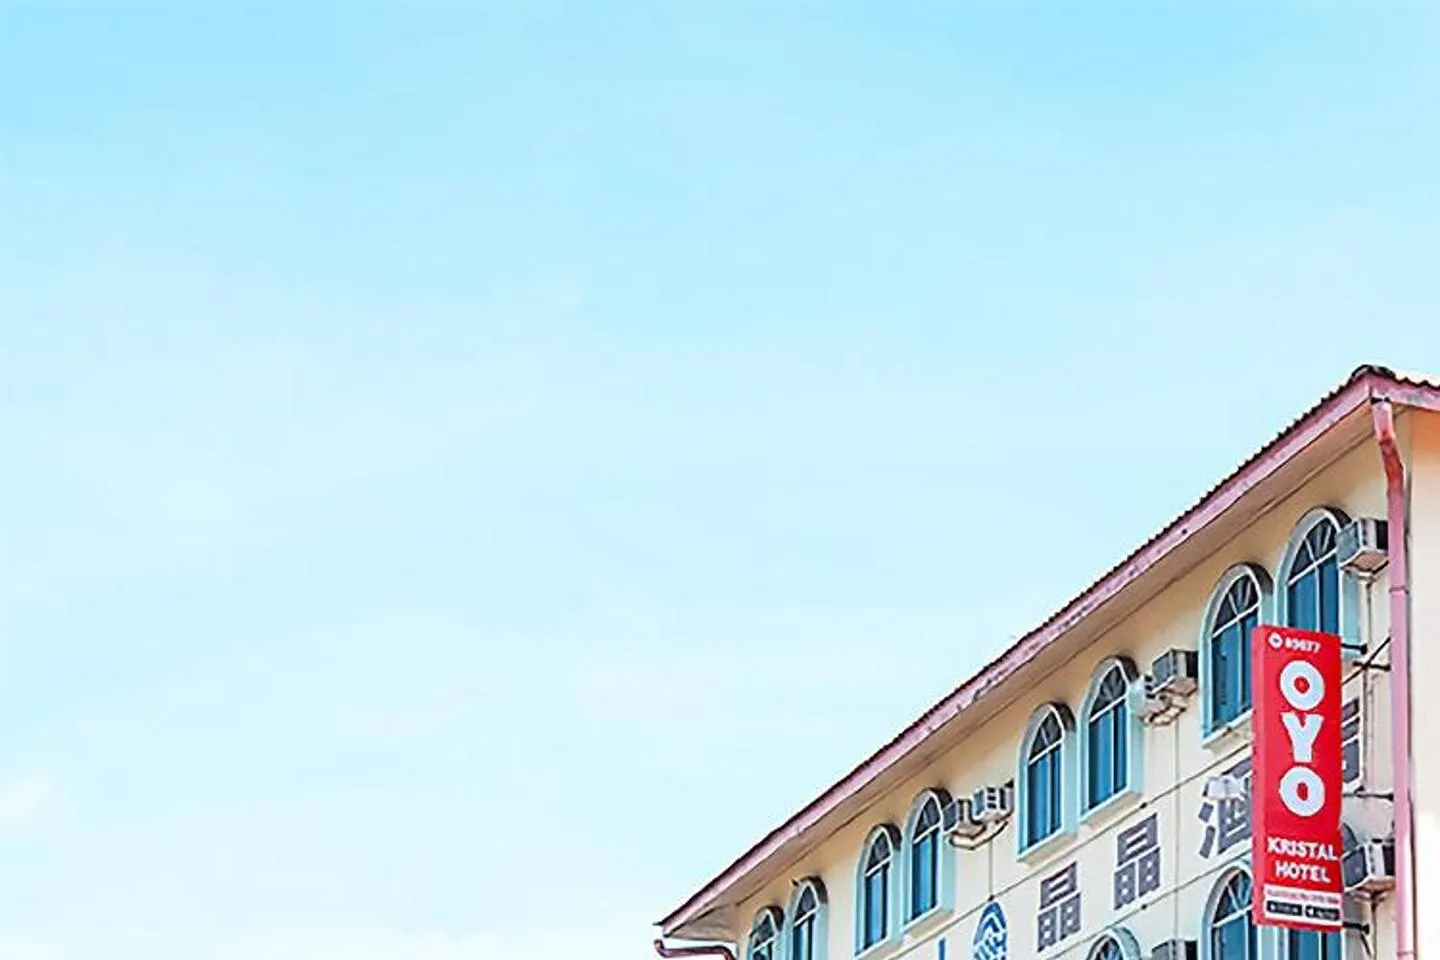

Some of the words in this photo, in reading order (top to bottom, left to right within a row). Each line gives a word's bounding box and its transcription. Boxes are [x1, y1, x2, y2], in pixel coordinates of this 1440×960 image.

[1279, 660, 1326, 817] OYO
[1267, 837, 1338, 860] KRISTAL
[1275, 860, 1331, 883] HOTEL
